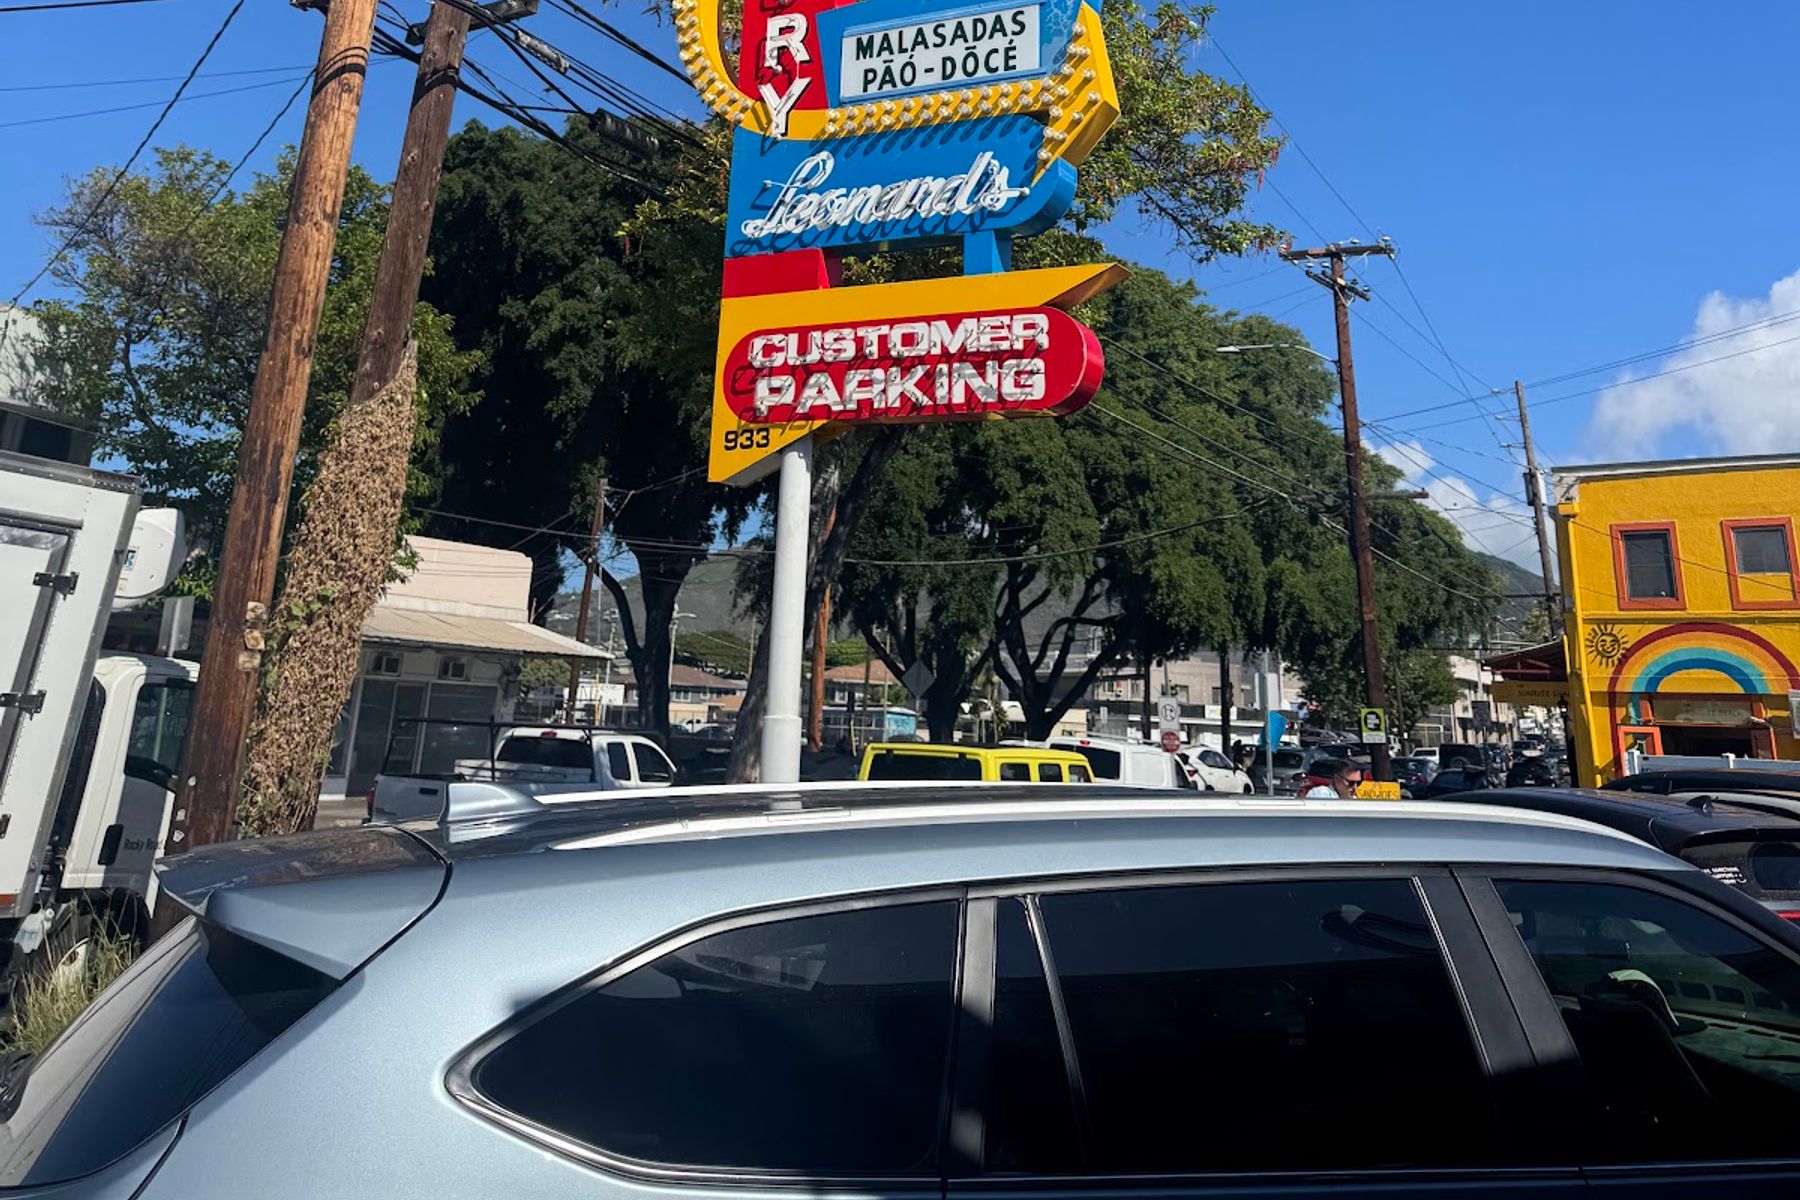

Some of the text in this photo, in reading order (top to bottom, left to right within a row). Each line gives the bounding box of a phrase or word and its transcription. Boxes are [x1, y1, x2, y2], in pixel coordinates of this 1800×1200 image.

[856, 10, 1027, 60] MALASADAS
[741, 151, 1030, 238] Leonard's
[747, 313, 1050, 368] CUSTOMER
[754, 357, 1046, 417] PARKING
[724, 428, 770, 451] 933
